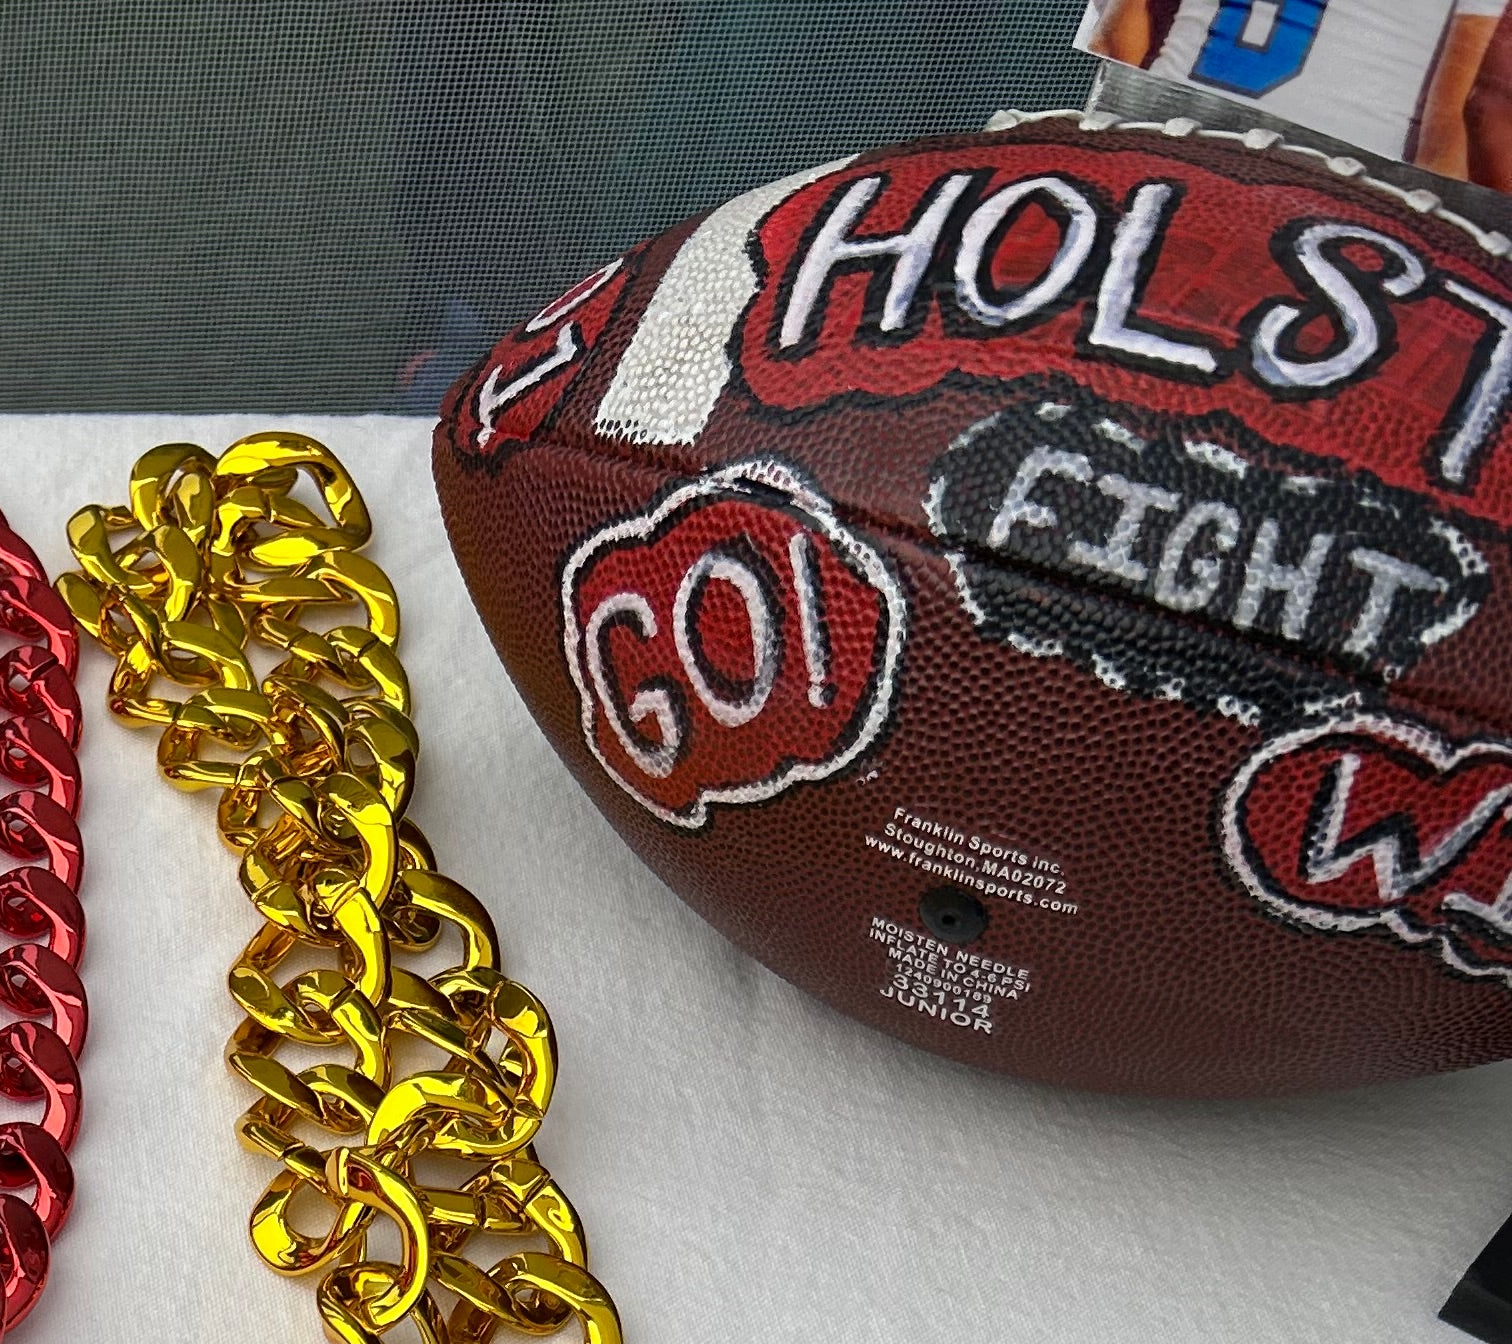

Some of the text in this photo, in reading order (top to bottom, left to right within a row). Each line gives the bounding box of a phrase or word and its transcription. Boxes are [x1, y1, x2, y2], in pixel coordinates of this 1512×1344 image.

[987, 444, 1450, 660] FIGHT
[584, 531, 831, 780] GO!
[893, 807, 965, 846] Franklin
[968, 836, 1028, 866] Sports
[864, 834, 1079, 915] www.franklinsports.com
[869, 927, 1031, 993] INFLATE TO 4-6 PSI
[871, 917, 1030, 980] MOISTEN NEEDLE
[888, 947, 1019, 1000] MADE IN CHINA
[880, 986, 993, 1035] JUNIOR
[892, 973, 990, 1019] 33114
